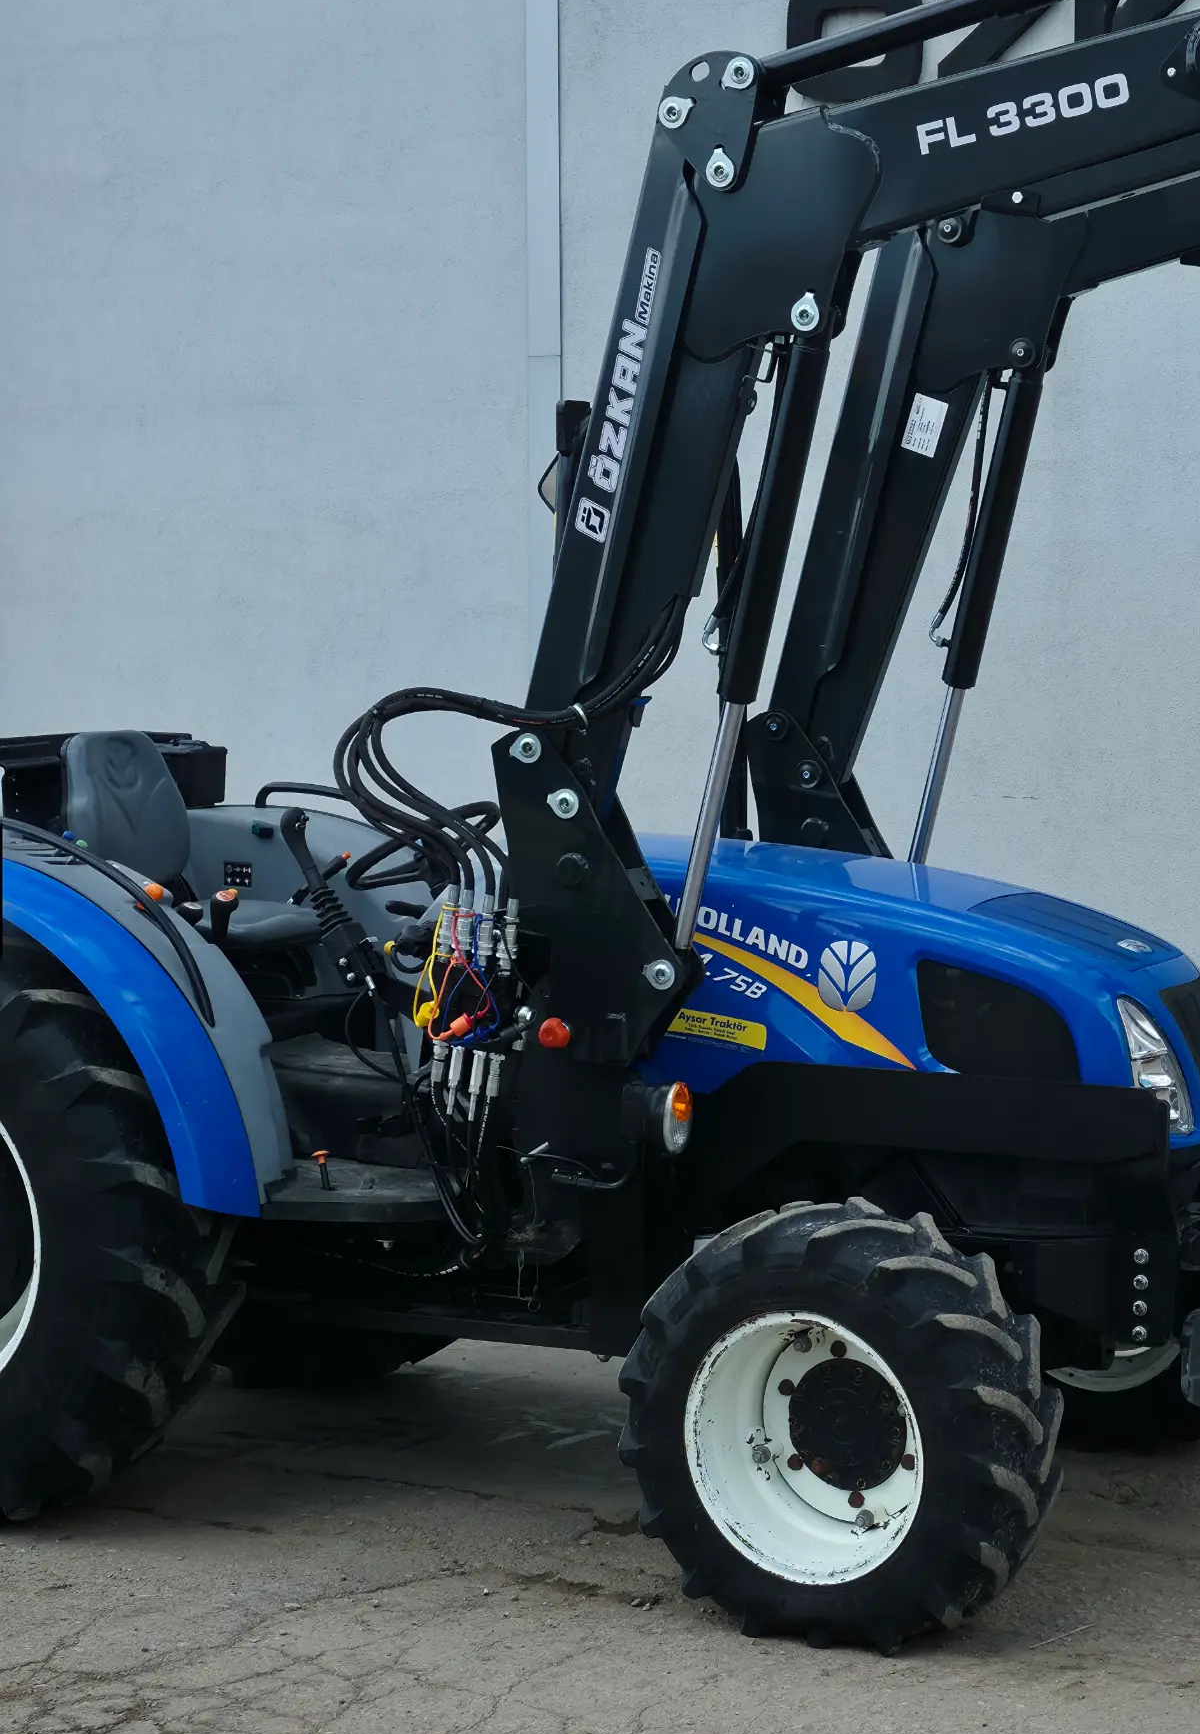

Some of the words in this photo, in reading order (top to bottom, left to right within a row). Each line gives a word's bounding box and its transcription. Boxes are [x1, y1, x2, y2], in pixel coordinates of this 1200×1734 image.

[916, 116, 977, 156] FL
[986, 73, 1130, 137] 3300
[588, 318, 648, 493] ÖZKAN
[637, 251, 660, 322] Makina
[697, 905, 809, 969] OLLAND
[678, 1011, 707, 1028] Aysar
[710, 1016, 748, 1032] Traktör
